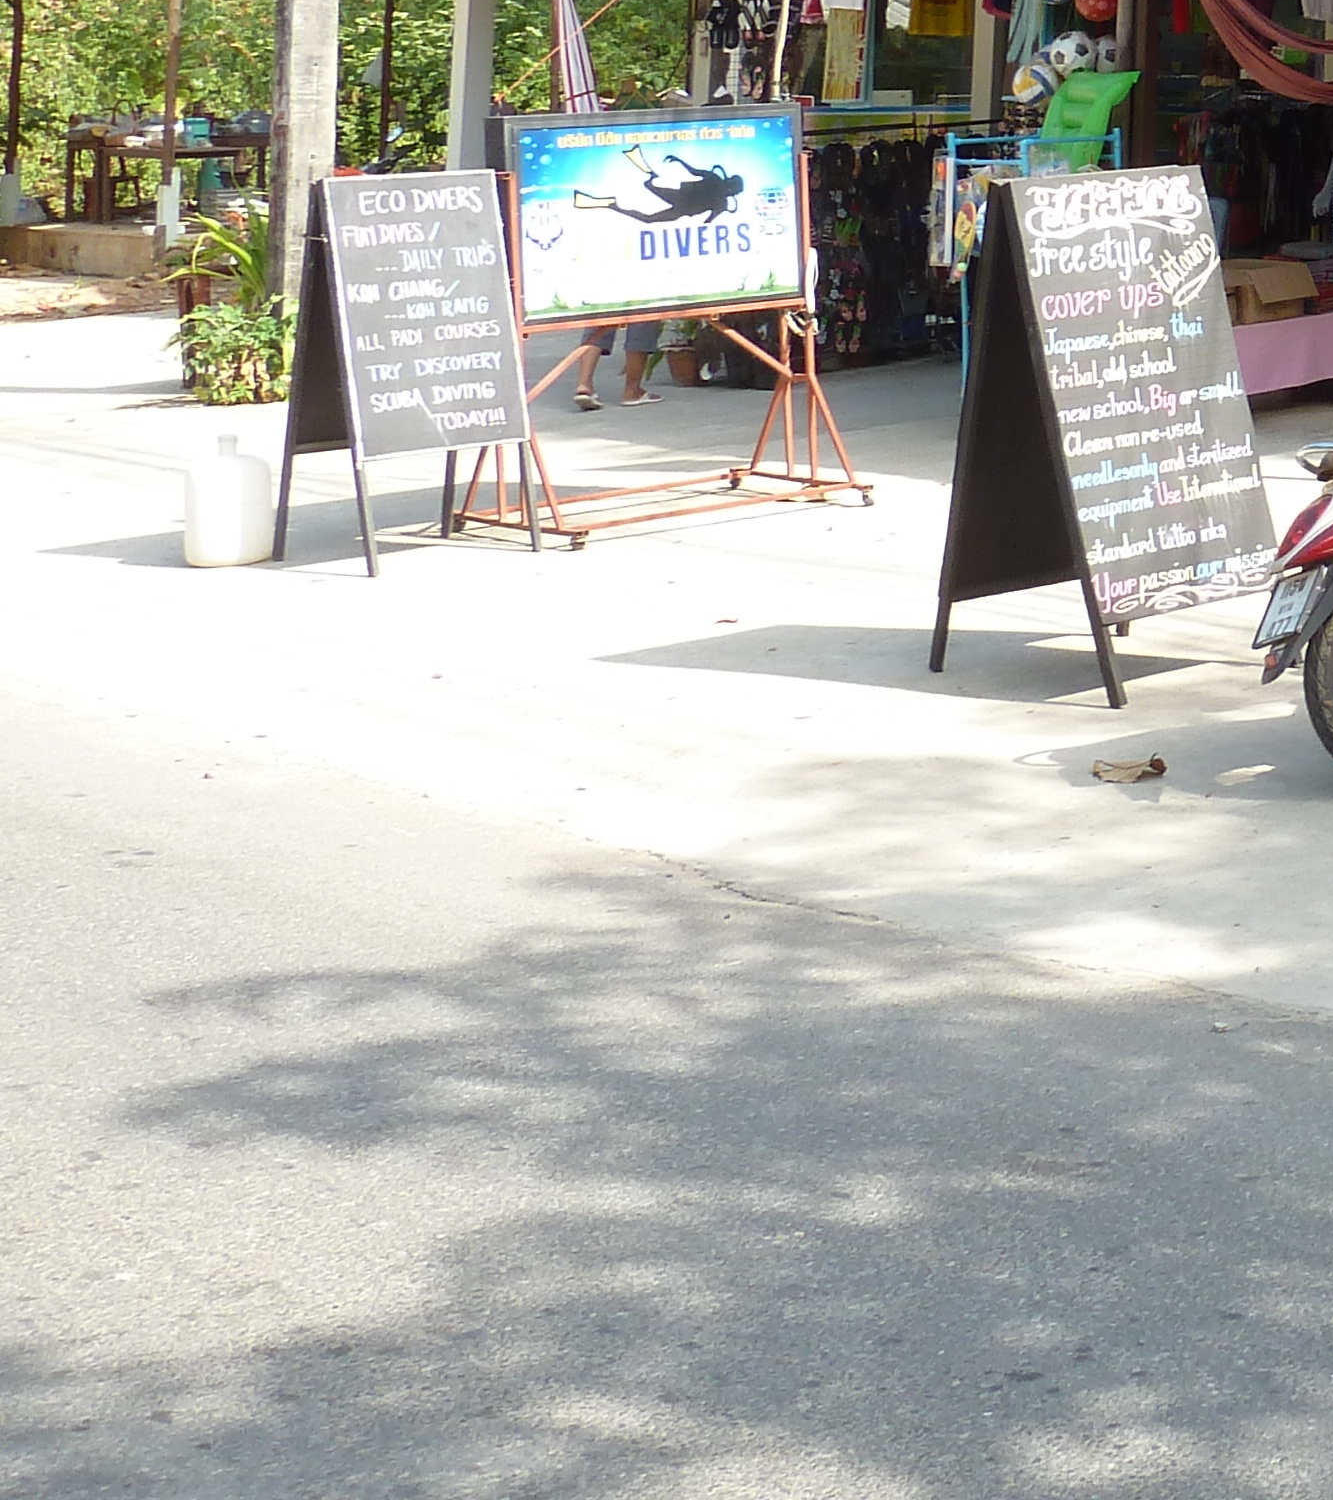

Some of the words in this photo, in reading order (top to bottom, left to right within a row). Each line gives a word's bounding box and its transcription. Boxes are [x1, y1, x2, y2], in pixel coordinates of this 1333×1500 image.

[358, 190, 406, 216] ECO
[413, 186, 483, 213] DIVERS
[341, 224, 376, 248] FUN
[379, 222, 424, 244] DIVES
[640, 223, 751, 260] DIVERS
[1030, 238, 1086, 278] free
[1089, 230, 1152, 281] style
[347, 283, 380, 304] KOH
[442, 296, 489, 317] RANG
[1041, 288, 1111, 321] cover
[1117, 281, 1164, 319] ups
[356, 334, 385, 352] ALL
[392, 330, 422, 347] PADI
[435, 320, 500, 340] COURSES
[1170, 311, 1203, 339] thai
[366, 362, 402, 382] TRY
[415, 352, 502, 377] DISCOVERY
[1130, 347, 1177, 380] school
[370, 388, 422, 414] SCUBA
[432, 381, 496, 405] DIVING
[1058, 405, 1090, 425] new
[1149, 384, 1177, 416] Big
[1179, 390, 1197, 406] or
[1199, 371, 1244, 403] small
[433, 407, 507, 430] TODAY!!!
[1064, 430, 1113, 458] Clean
[1115, 432, 1140, 448] non
[1142, 409, 1204, 446] re-used
[1159, 445, 1185, 474] and
[1077, 485, 1154, 528] equipment
[1156, 480, 1181, 508] Use
[1086, 532, 1157, 566] standard
[1157, 523, 1196, 550] tattoo
[1200, 516, 1227, 541] inks
[1090, 570, 1137, 614] Your
[1196, 560, 1225, 579] our
